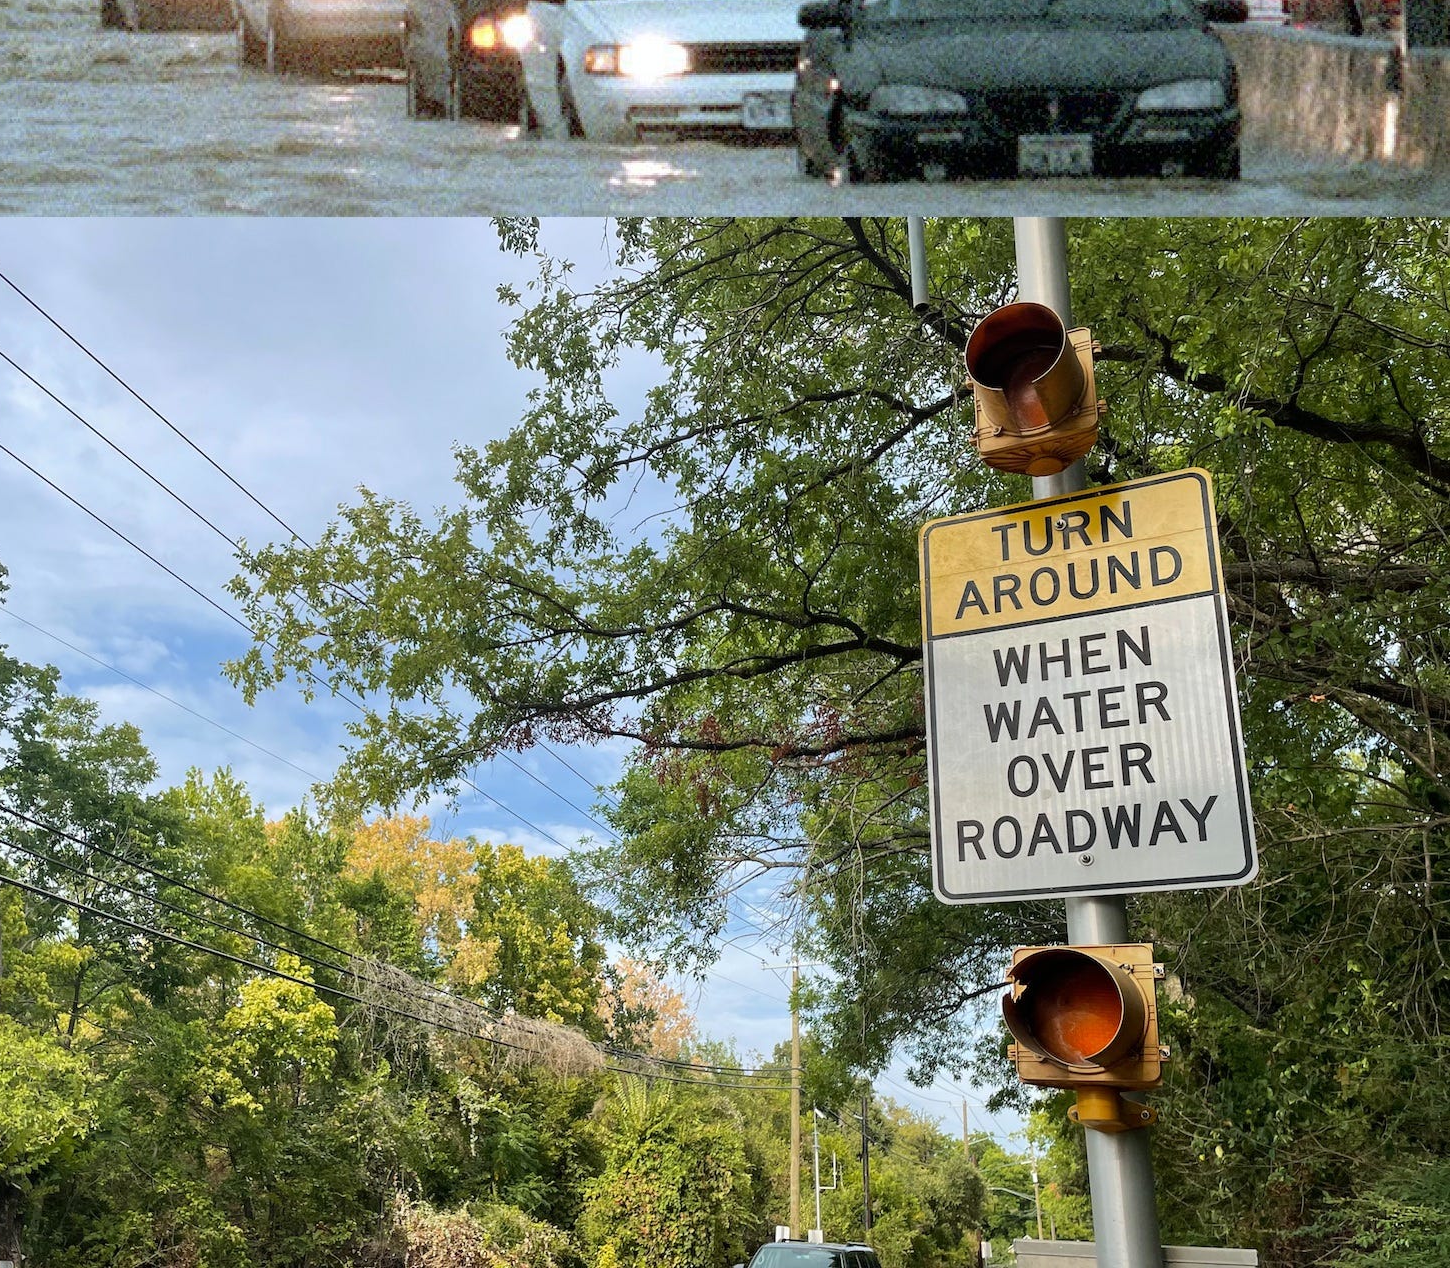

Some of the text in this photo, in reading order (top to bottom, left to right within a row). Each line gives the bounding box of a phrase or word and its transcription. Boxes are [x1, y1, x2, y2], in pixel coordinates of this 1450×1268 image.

[992, 501, 1133, 561] TURN
[955, 546, 1182, 620] AROUND
[993, 626, 1151, 687] WHEN
[984, 682, 1172, 743] WATER
[1007, 742, 1156, 798] OVER
[957, 795, 1218, 862] ROADWAY
